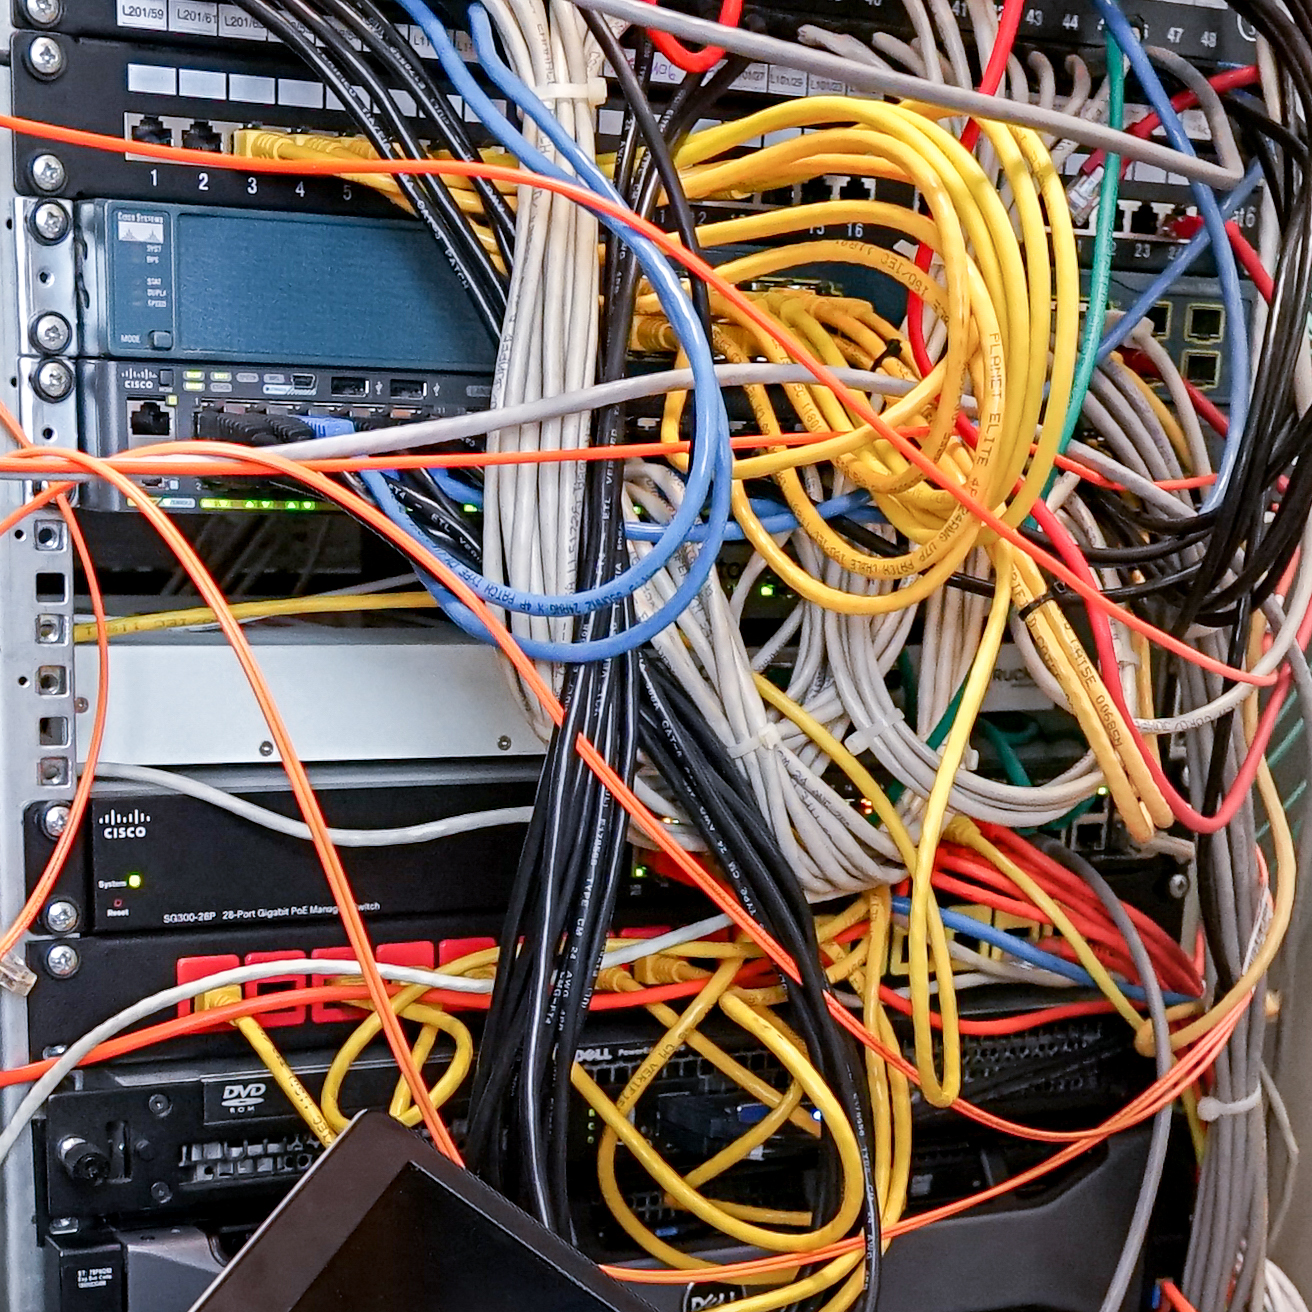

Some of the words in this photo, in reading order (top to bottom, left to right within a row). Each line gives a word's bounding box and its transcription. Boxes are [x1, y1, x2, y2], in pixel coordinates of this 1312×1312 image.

[122, 4, 164, 20] L201/59
[1026, 9, 1043, 26] 43
[1062, 13, 1079, 30] 44
[1167, 27, 1184, 44] 47
[1201, 29, 1217, 47] 48
[149, 169, 158, 187] 1
[198, 173, 209, 191] 2
[247, 176, 258, 195] 3
[295, 181, 305, 197] 4
[343, 184, 352, 200] 5
[1231, 206, 1256, 228] at6
[846, 223, 863, 238] 16
[1134, 244, 1151, 258] 23
[444, 250, 469, 291] PATCH
[989, 332, 1002, 400] PLANET
[124, 380, 153, 389] CISCO
[976, 412, 1001, 467] ELITE
[602, 498, 613, 521] ETL
[430, 514, 451, 532] ETL
[699, 806, 715, 832] AWG
[104, 826, 147, 839] CISCO
[718, 840, 727, 854] 24
[728, 861, 740, 879] CM
[581, 879, 594, 906] TYPE
[740, 886, 757, 916] TYPE
[107, 908, 129, 917] Reset
[222, 910, 256, 921] 28-Port
[258, 906, 289, 919] Gigabit
[291, 905, 308, 916] PoE
[357, 901, 380, 912] witch
[575, 918, 586, 937] CM
[570, 946, 579, 960] 24
[563, 970, 573, 998] AWG
[575, 1047, 612, 1062] DELL
[223, 1083, 266, 1099] DVD
